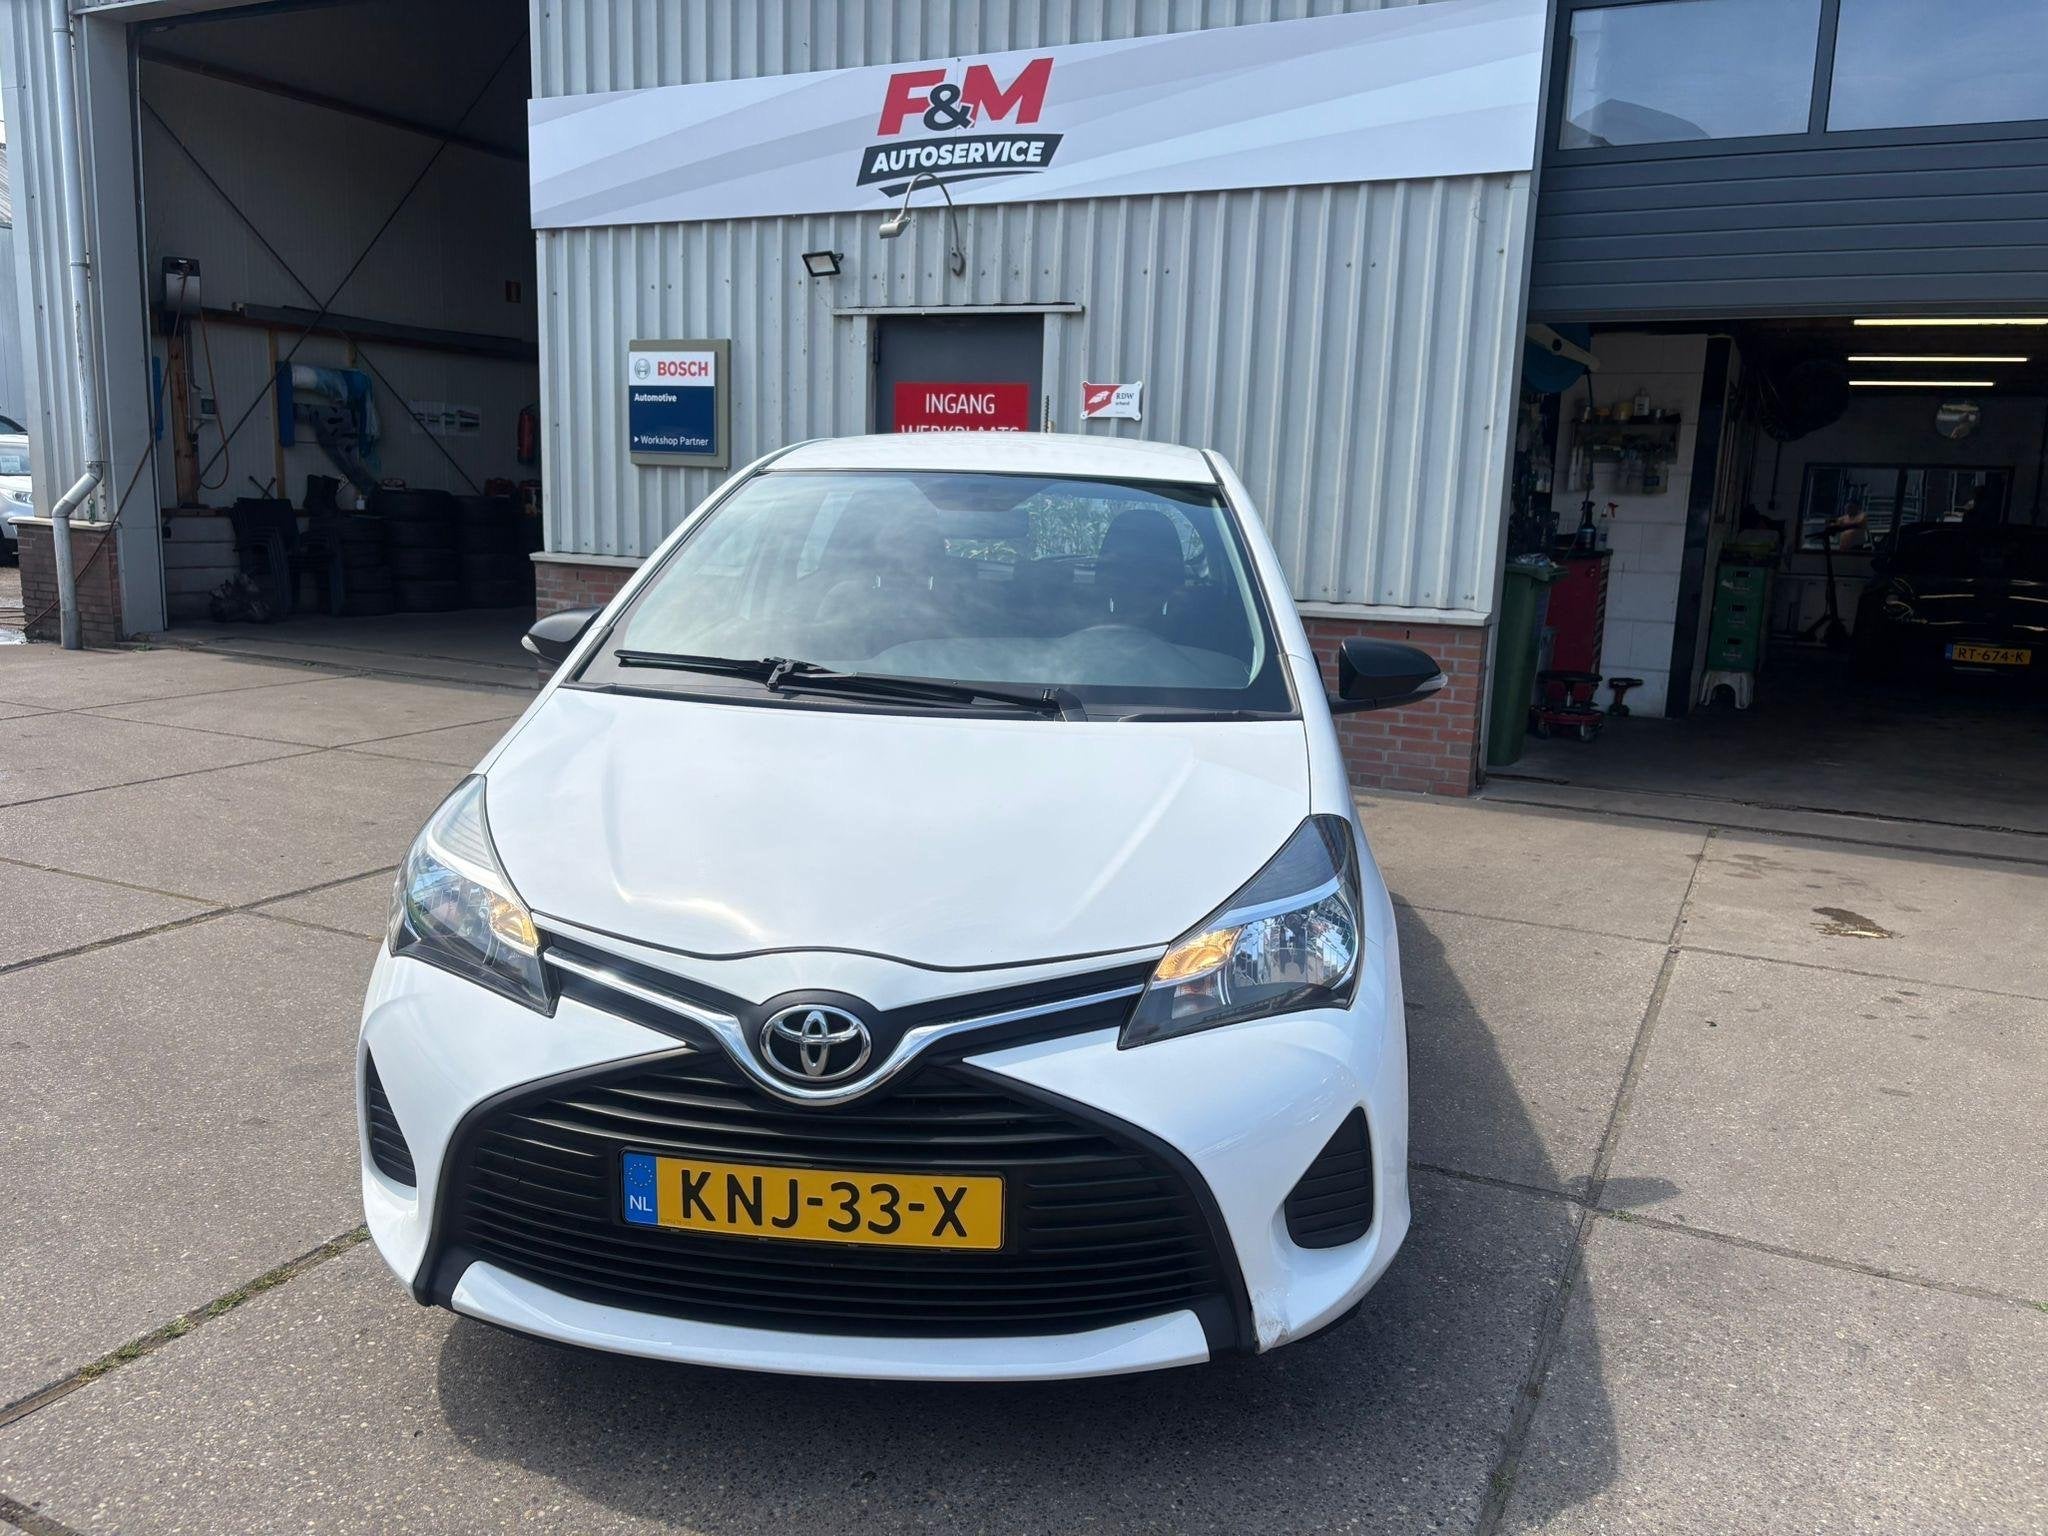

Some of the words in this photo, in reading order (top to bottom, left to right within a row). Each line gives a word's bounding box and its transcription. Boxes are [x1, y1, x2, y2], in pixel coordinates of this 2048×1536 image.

[877, 57, 1054, 136] F&M
[870, 140, 1045, 174] AUTOSERVICE
[657, 361, 708, 376] BOSCH
[634, 393, 677, 402] Automotive
[925, 393, 995, 415] INGANG
[1115, 392, 1135, 400] RDW
[640, 435, 678, 446] Workshop
[680, 436, 709, 446] Partner
[1958, 646, 2024, 663] RT-674-K
[629, 1194, 653, 1213] NL
[681, 1169, 967, 1238] KNJ-33-X
